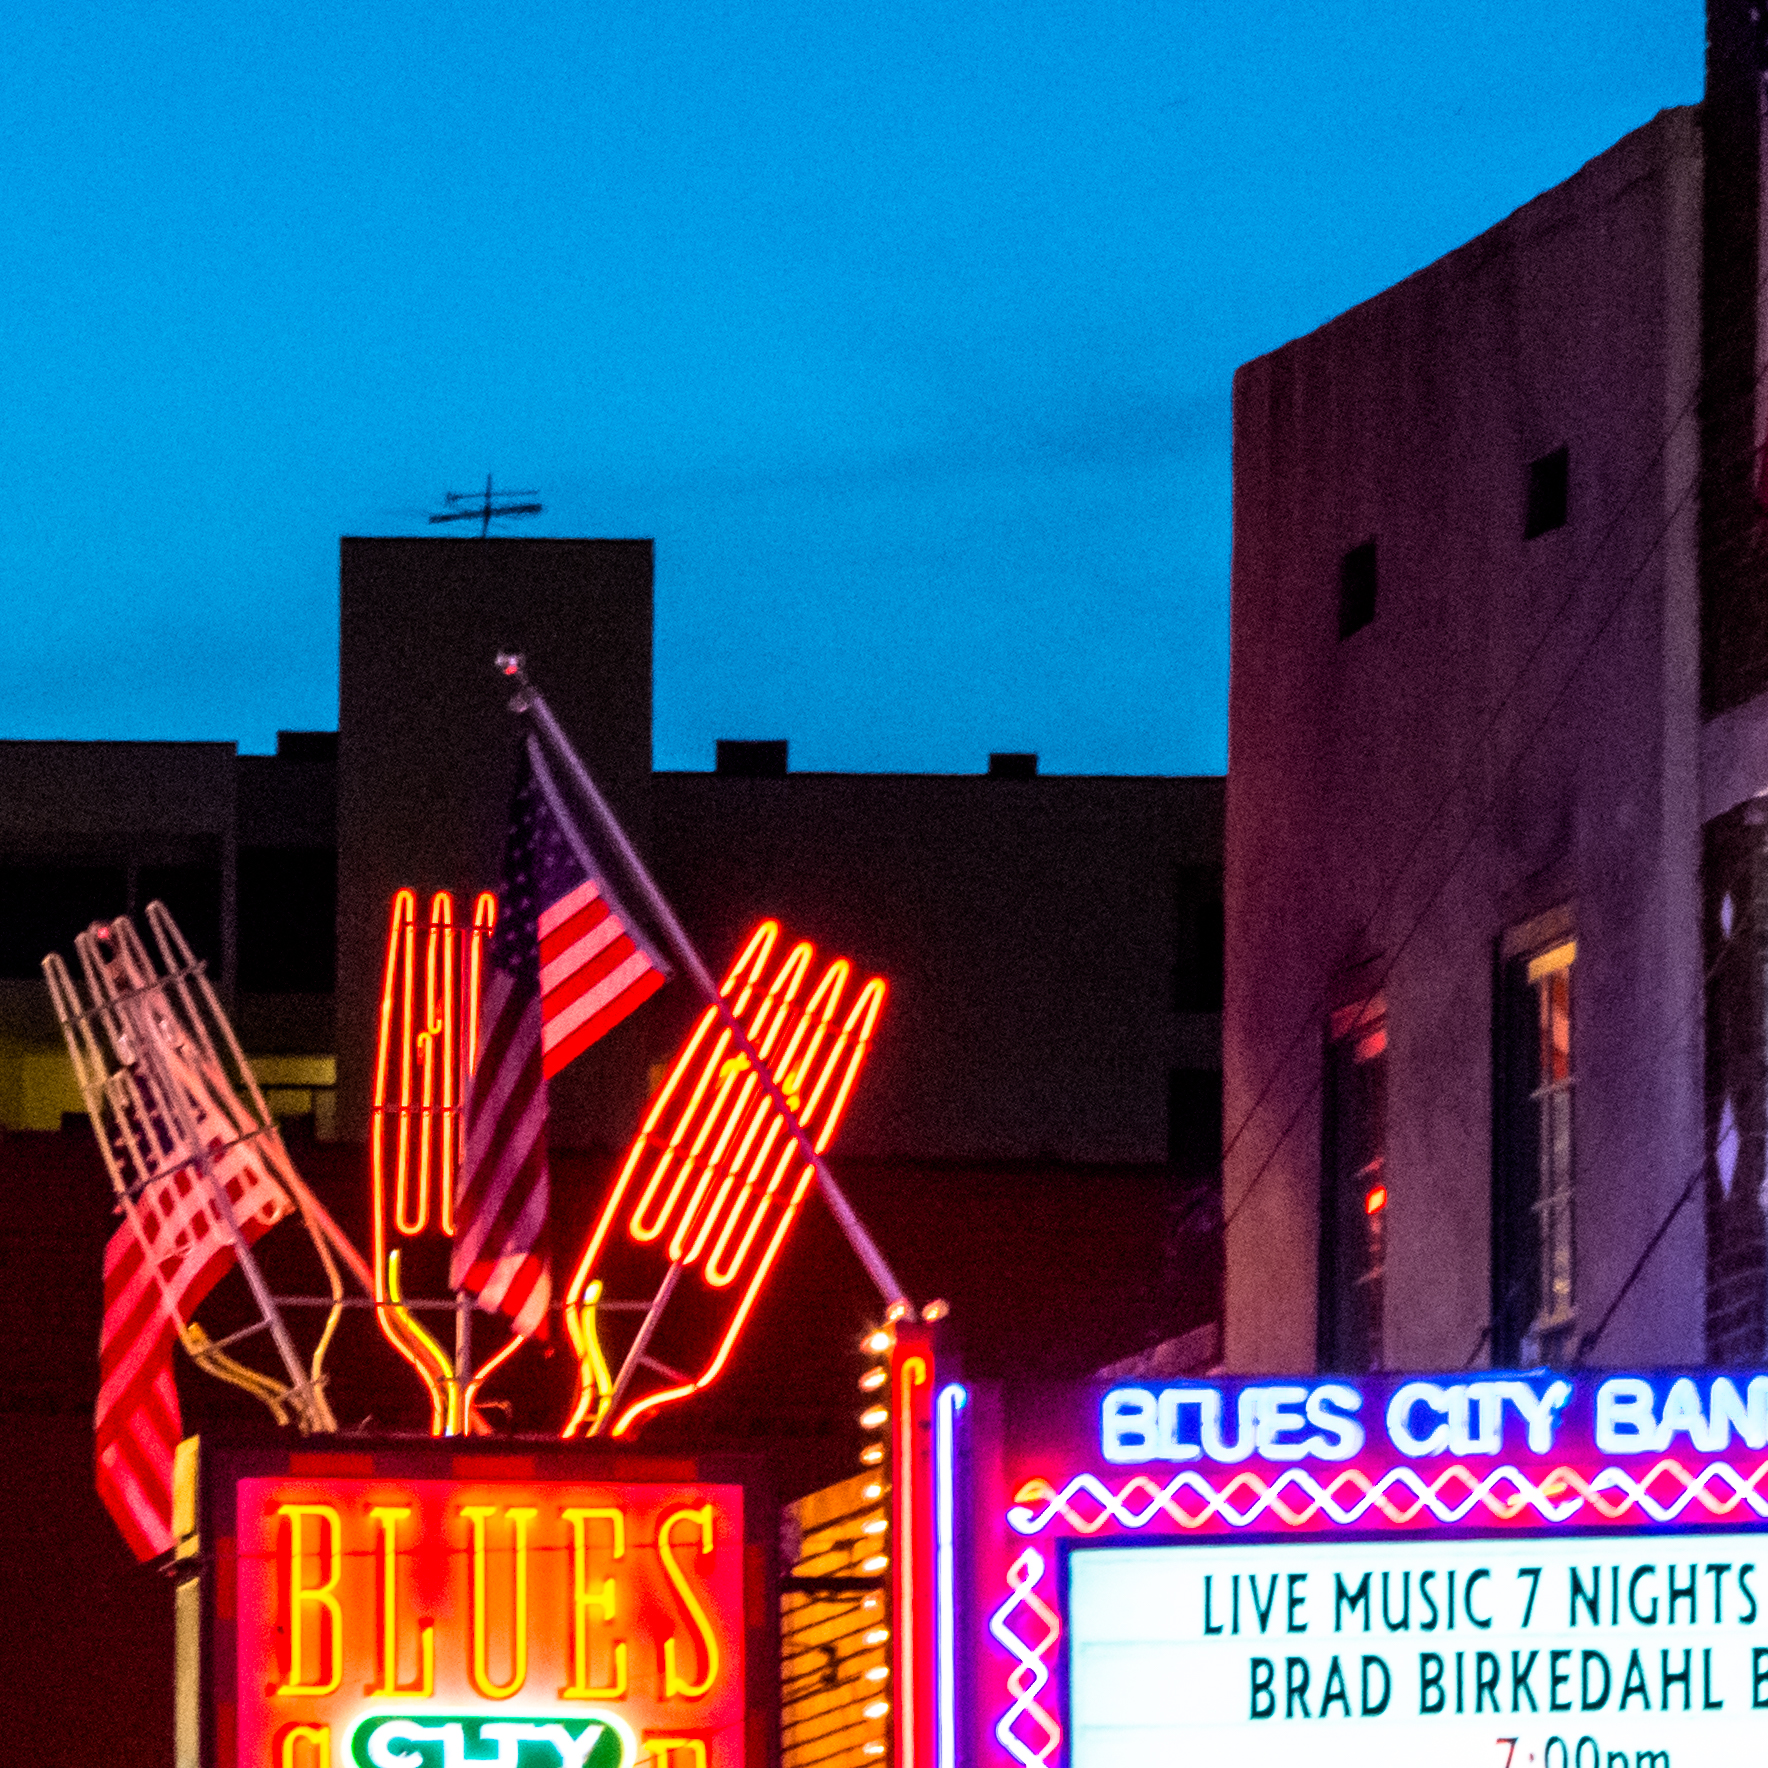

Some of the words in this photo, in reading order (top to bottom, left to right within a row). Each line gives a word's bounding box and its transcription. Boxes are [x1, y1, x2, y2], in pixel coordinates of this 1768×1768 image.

[1100, 1383, 1366, 1463] BLUES
[1386, 1380, 1572, 1458] CITY
[276, 1502, 722, 1702] BLUES
[1202, 1573, 1309, 1637] LIVE
[1333, 1568, 1494, 1633] MUSIC
[1517, 1566, 1543, 1629] 7
[1569, 1562, 1758, 1628] NIGHTS
[1249, 1654, 1392, 1720] BRAD
[1418, 1647, 1724, 1715] BIRKEDAHL
